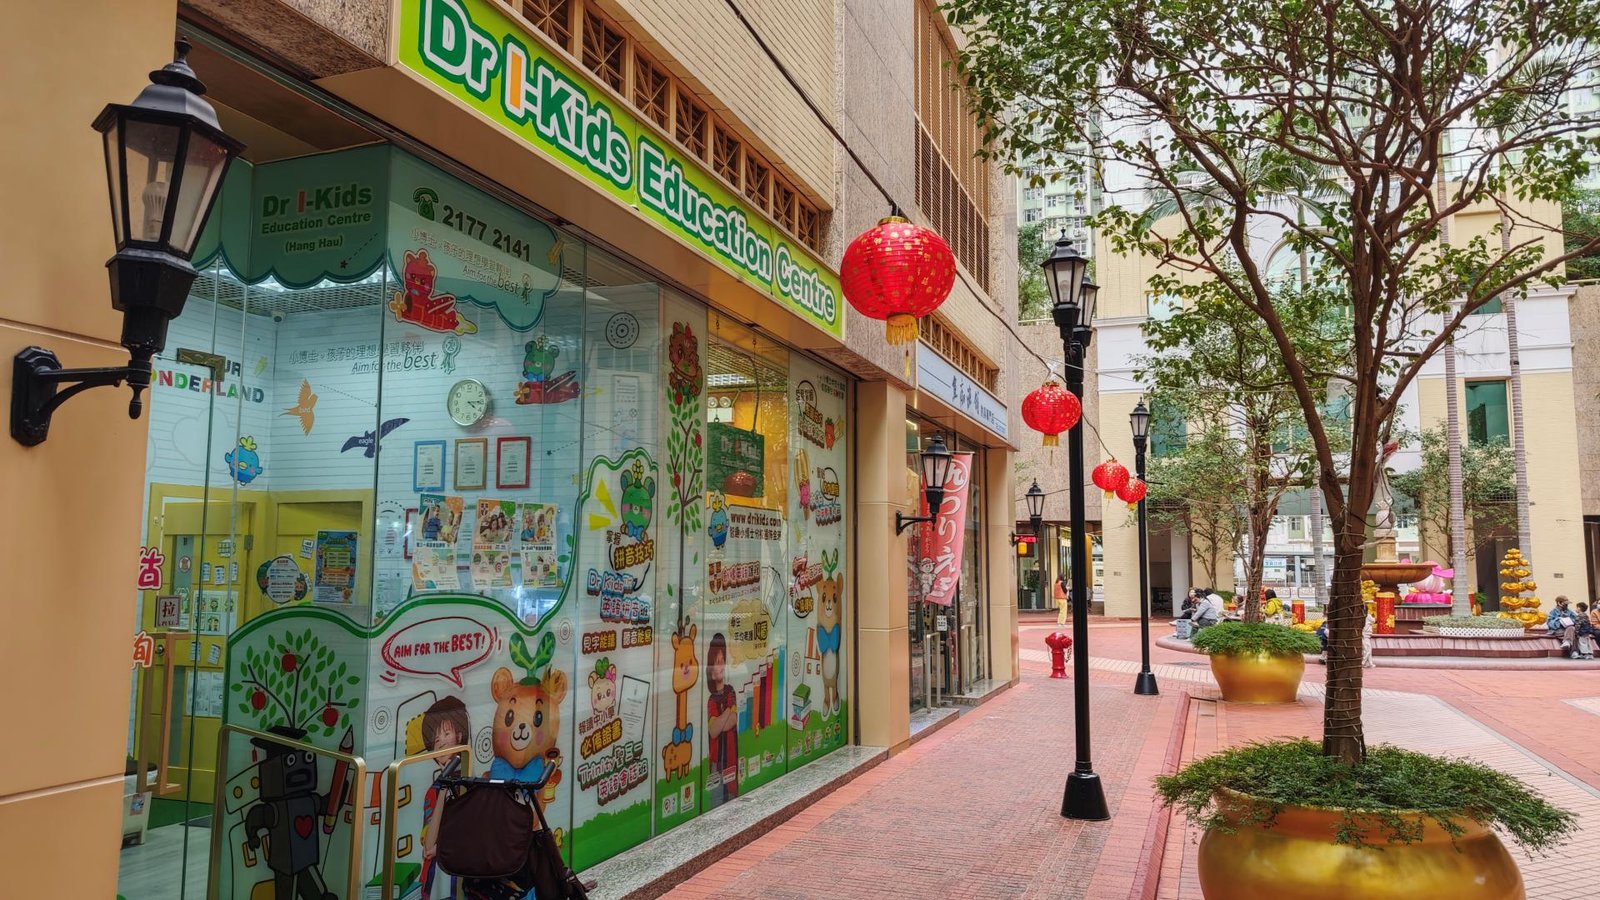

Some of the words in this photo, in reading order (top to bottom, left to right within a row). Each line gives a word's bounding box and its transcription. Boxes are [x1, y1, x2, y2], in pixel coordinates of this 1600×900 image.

[424, 0, 497, 94] Dr
[506, 41, 631, 185] I-Kids
[640, 142, 772, 284] Education
[776, 247, 836, 324] Centre
[262, 195, 290, 217] Dr
[297, 184, 372, 213] I-Kids
[261, 216, 323, 235] Education
[327, 211, 371, 226] Centre
[443, 205, 488, 241] 2177
[492, 229, 531, 262] 2141
[285, 238, 316, 253] (Hang
[319, 235, 343, 250] Hau)
[462, 265, 476, 276] Aim
[487, 273, 498, 285] the
[498, 272, 520, 294] best
[352, 362, 368, 374] Aim
[388, 359, 401, 371] the
[404, 352, 437, 371] best
[613, 540, 654, 571] 拼音技巧
[588, 569, 602, 588] Dr
[603, 573, 624, 593] Kids
[162, 600, 175, 618] 拉
[601, 597, 649, 618] 英語拼音班
[394, 645, 411, 658] AIM
[414, 643, 431, 656] FOR
[433, 640, 450, 654] THE
[451, 632, 486, 653] BEST!
[581, 718, 622, 759] 必備證書
[579, 757, 614, 785] Trinity
[599, 760, 648, 798] 英語會話班
